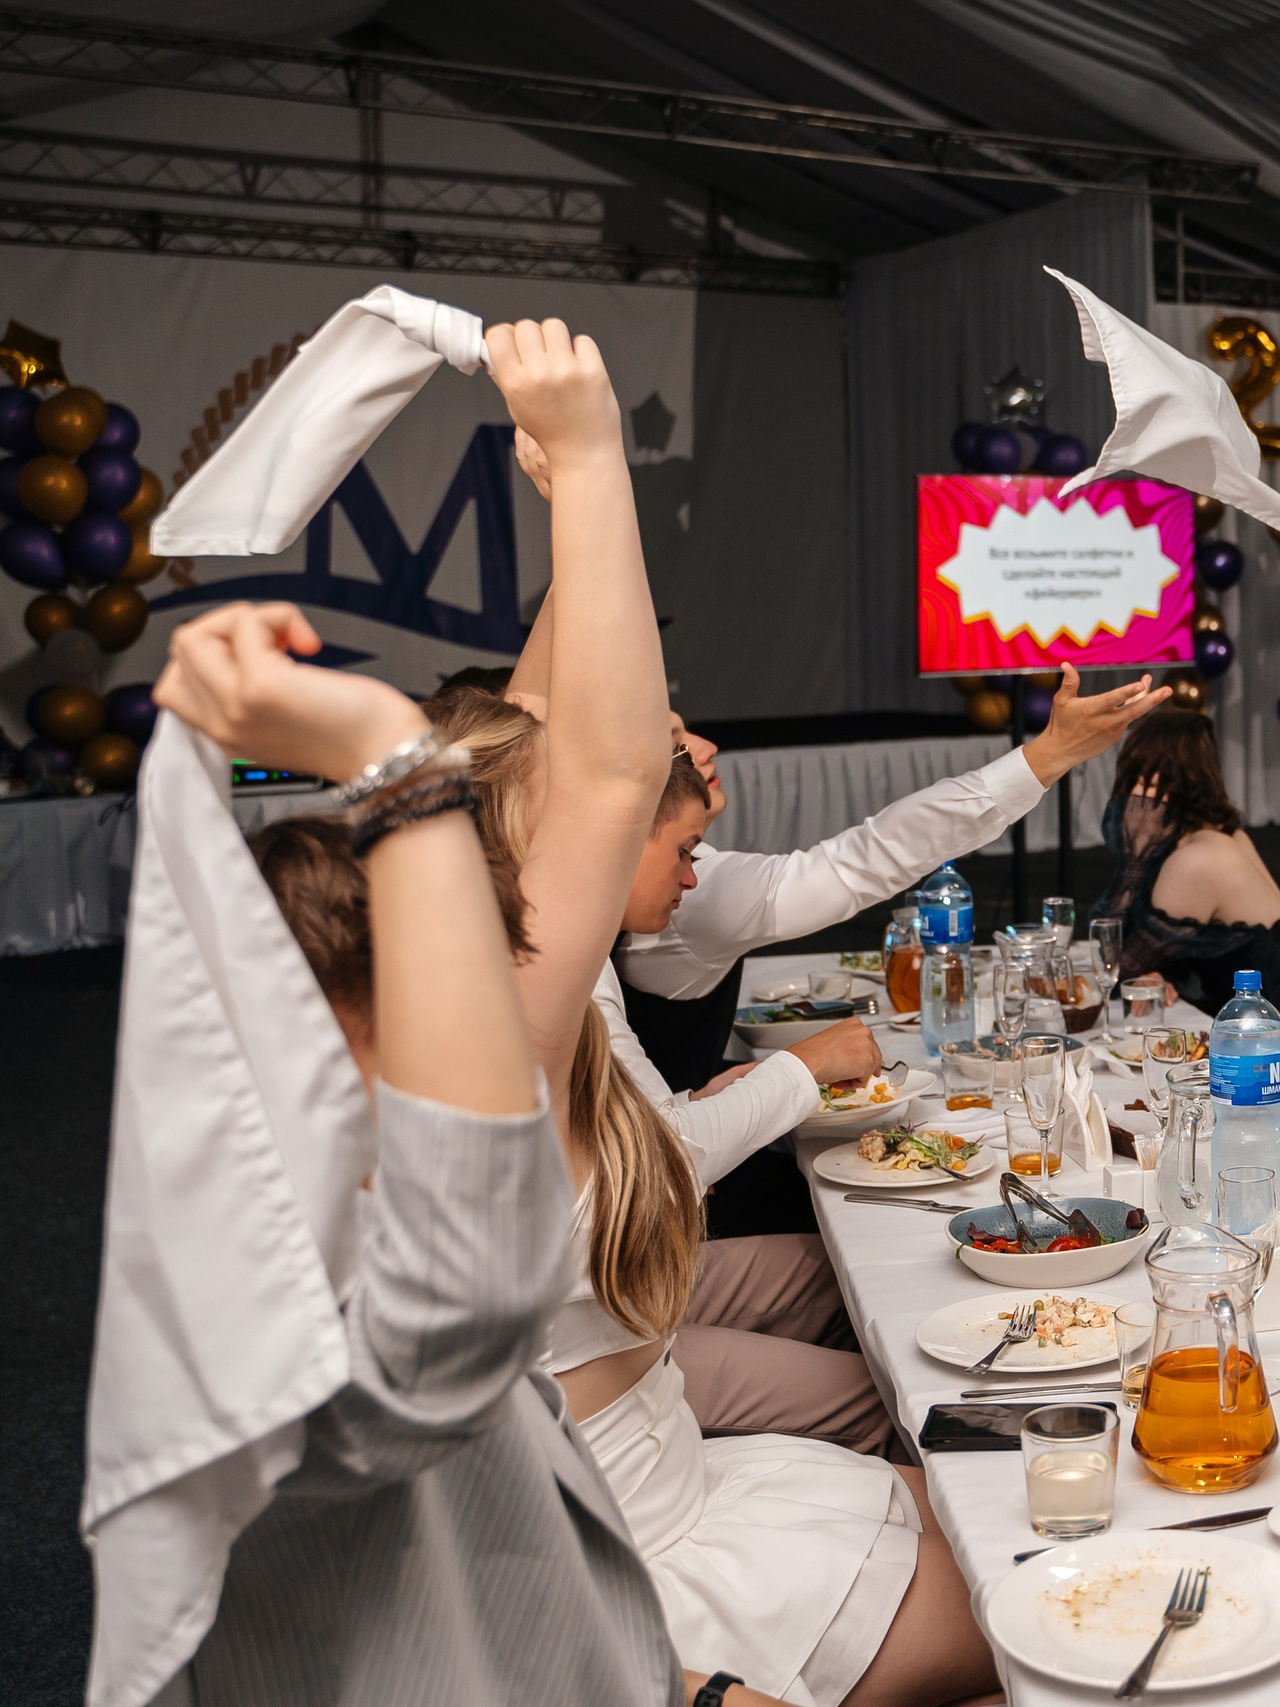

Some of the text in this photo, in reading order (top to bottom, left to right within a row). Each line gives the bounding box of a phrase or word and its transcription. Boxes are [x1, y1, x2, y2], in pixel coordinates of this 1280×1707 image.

[990, 547, 1009, 559] Все
[1072, 547, 1123, 561] салфетки
[1060, 566, 1121, 580] настоящий
